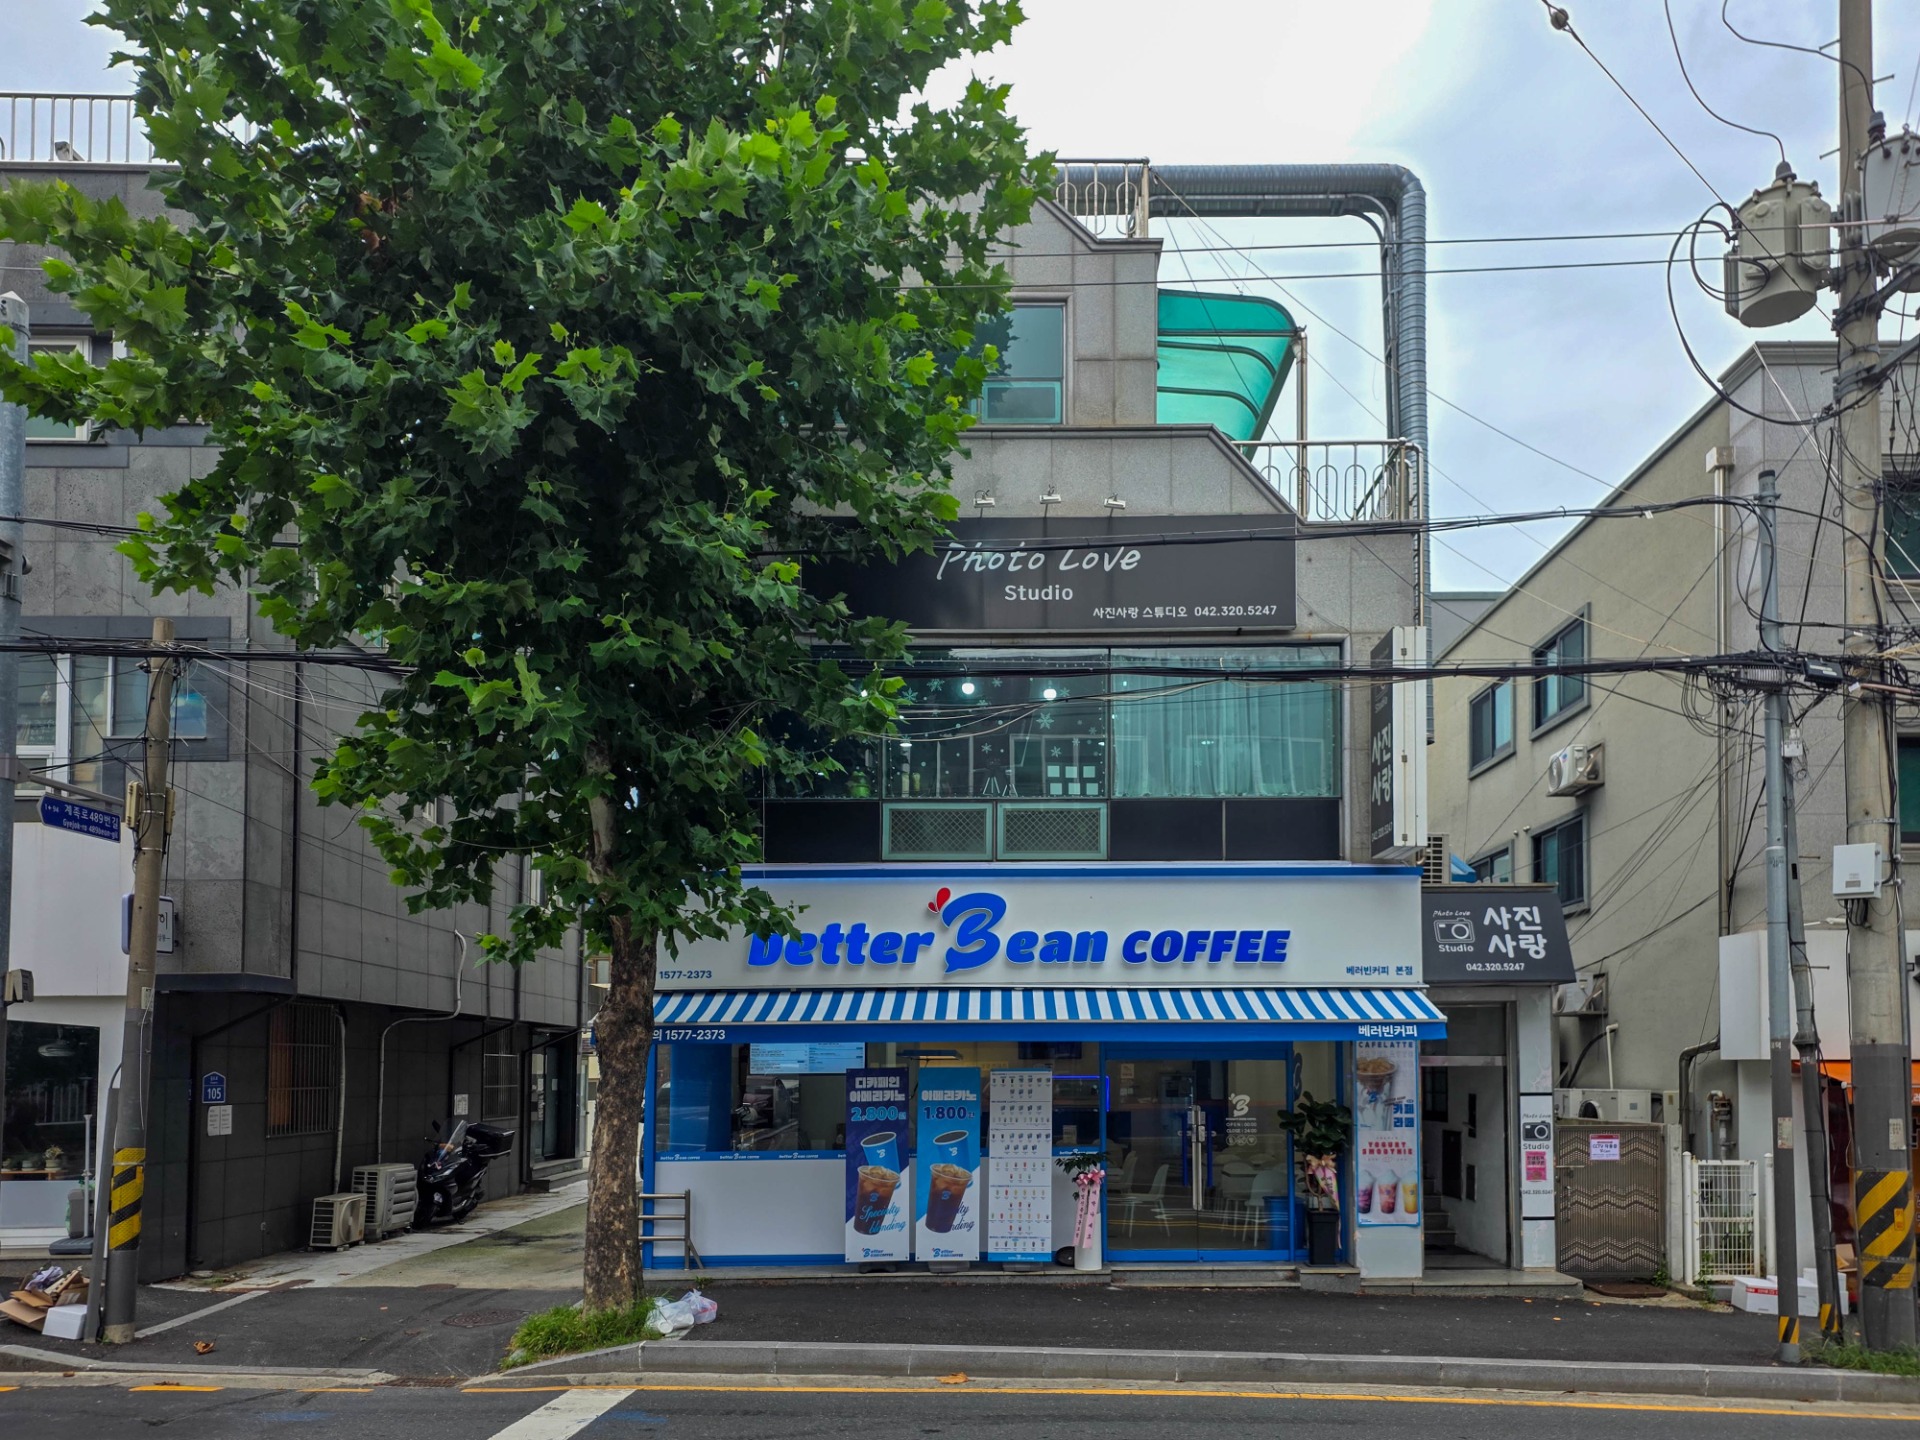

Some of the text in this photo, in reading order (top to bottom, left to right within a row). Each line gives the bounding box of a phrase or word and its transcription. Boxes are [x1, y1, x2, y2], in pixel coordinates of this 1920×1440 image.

[937, 542, 1141, 579] Photo Love
[1004, 584, 1073, 600] Studio
[1093, 605, 1277, 619] 사진사랑 스튜디오 042.320.5247
[1371, 722, 1391, 766] 사진
[1371, 764, 1392, 806] 사랑
[1483, 905, 1542, 932] 사진
[941, 891, 1109, 974] Bean
[1438, 943, 1474, 952] Studio
[1487, 933, 1548, 960] 사랑
[1345, 966, 1413, 976] 베러빈커피 본점
[1466, 962, 1525, 971] 042.320.5247
[659, 970, 712, 979] 1577-2373
[665, 1029, 726, 1041] 1577-2373
[1357, 1024, 1418, 1037] 베러빈커피
[207, 1088, 222, 1100] 105
